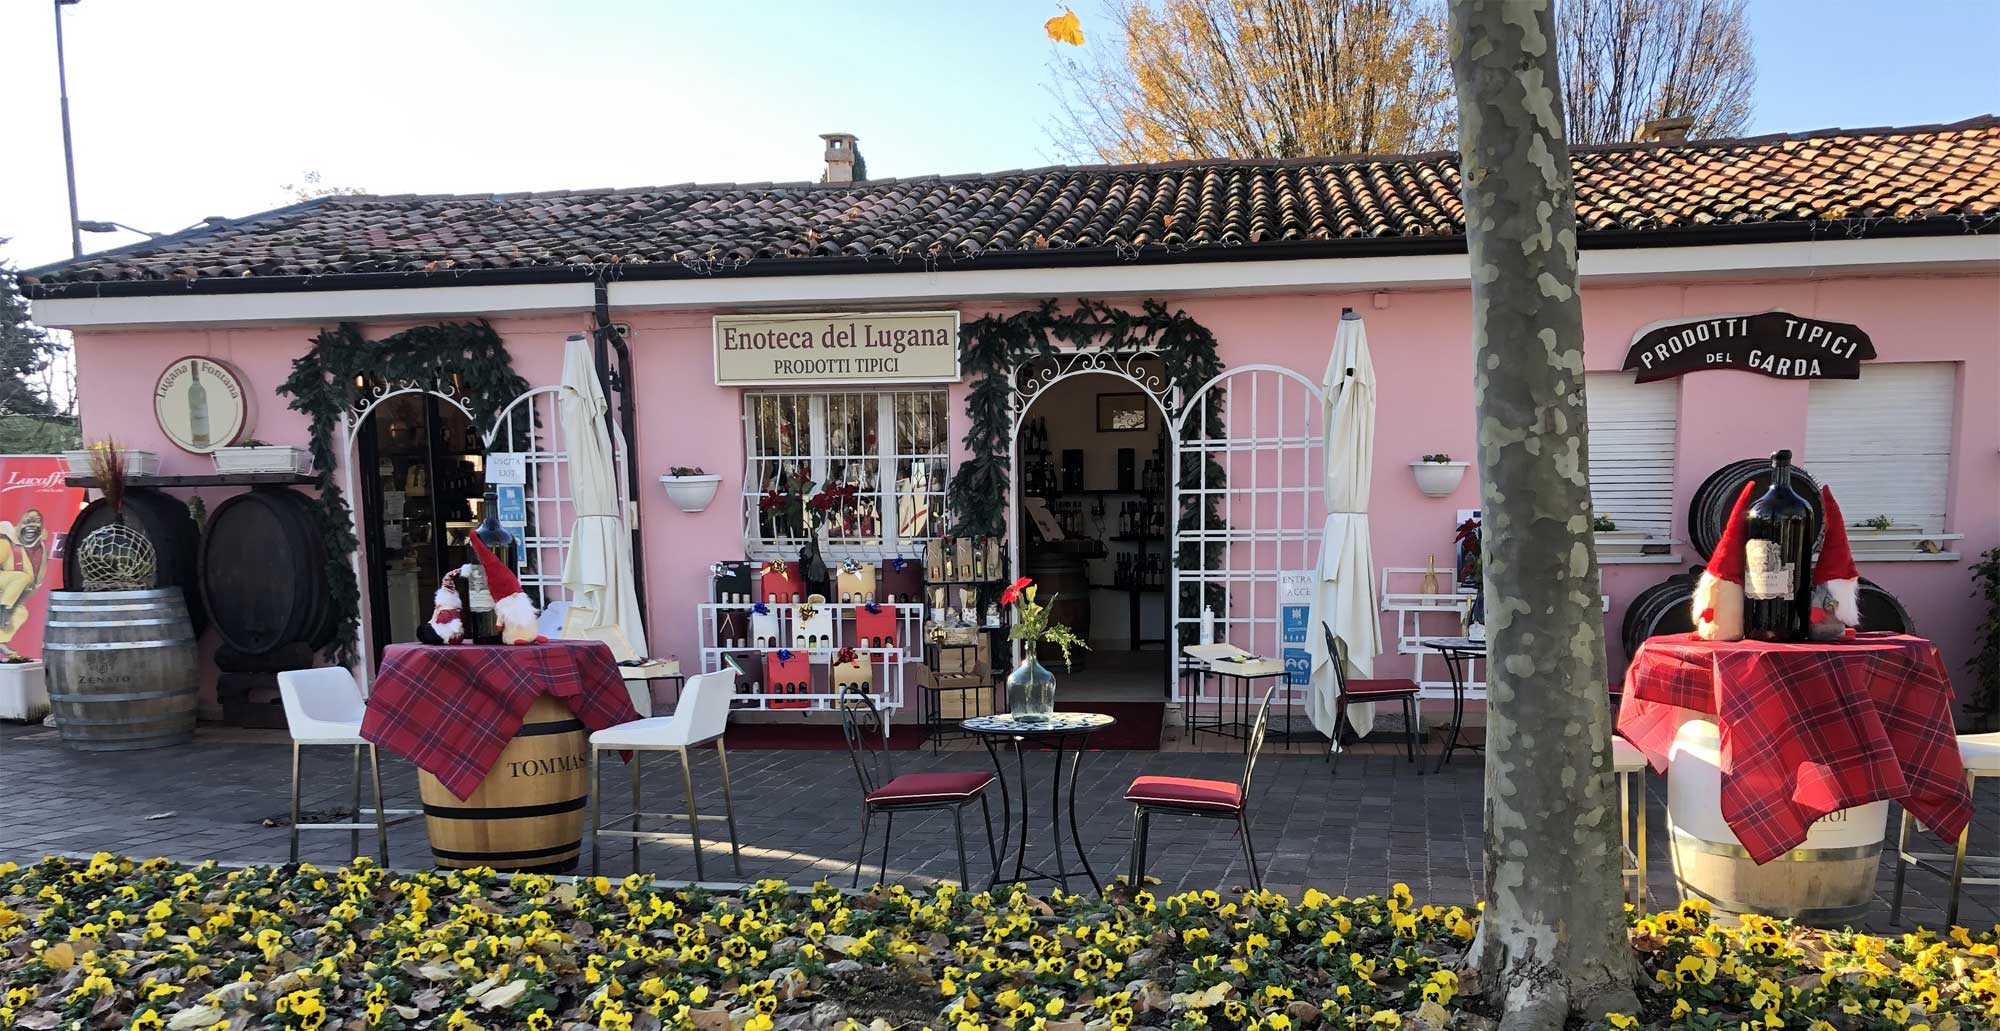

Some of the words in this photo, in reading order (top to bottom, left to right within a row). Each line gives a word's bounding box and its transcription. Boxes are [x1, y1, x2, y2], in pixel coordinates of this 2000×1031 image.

[723, 327, 814, 350] Enoteca
[822, 323, 857, 348] del
[864, 324, 949, 353] Lugana
[1640, 319, 1748, 369] PRODOTTI
[1785, 319, 1858, 359] TIPICI
[774, 359, 850, 374] PRODOTTI
[855, 358, 899, 372] TIPICI
[1706, 352, 1733, 364] DEL
[1748, 349, 1822, 376] GARDA
[156, 365, 188, 398] Lugana
[202, 361, 239, 399] Fontana
